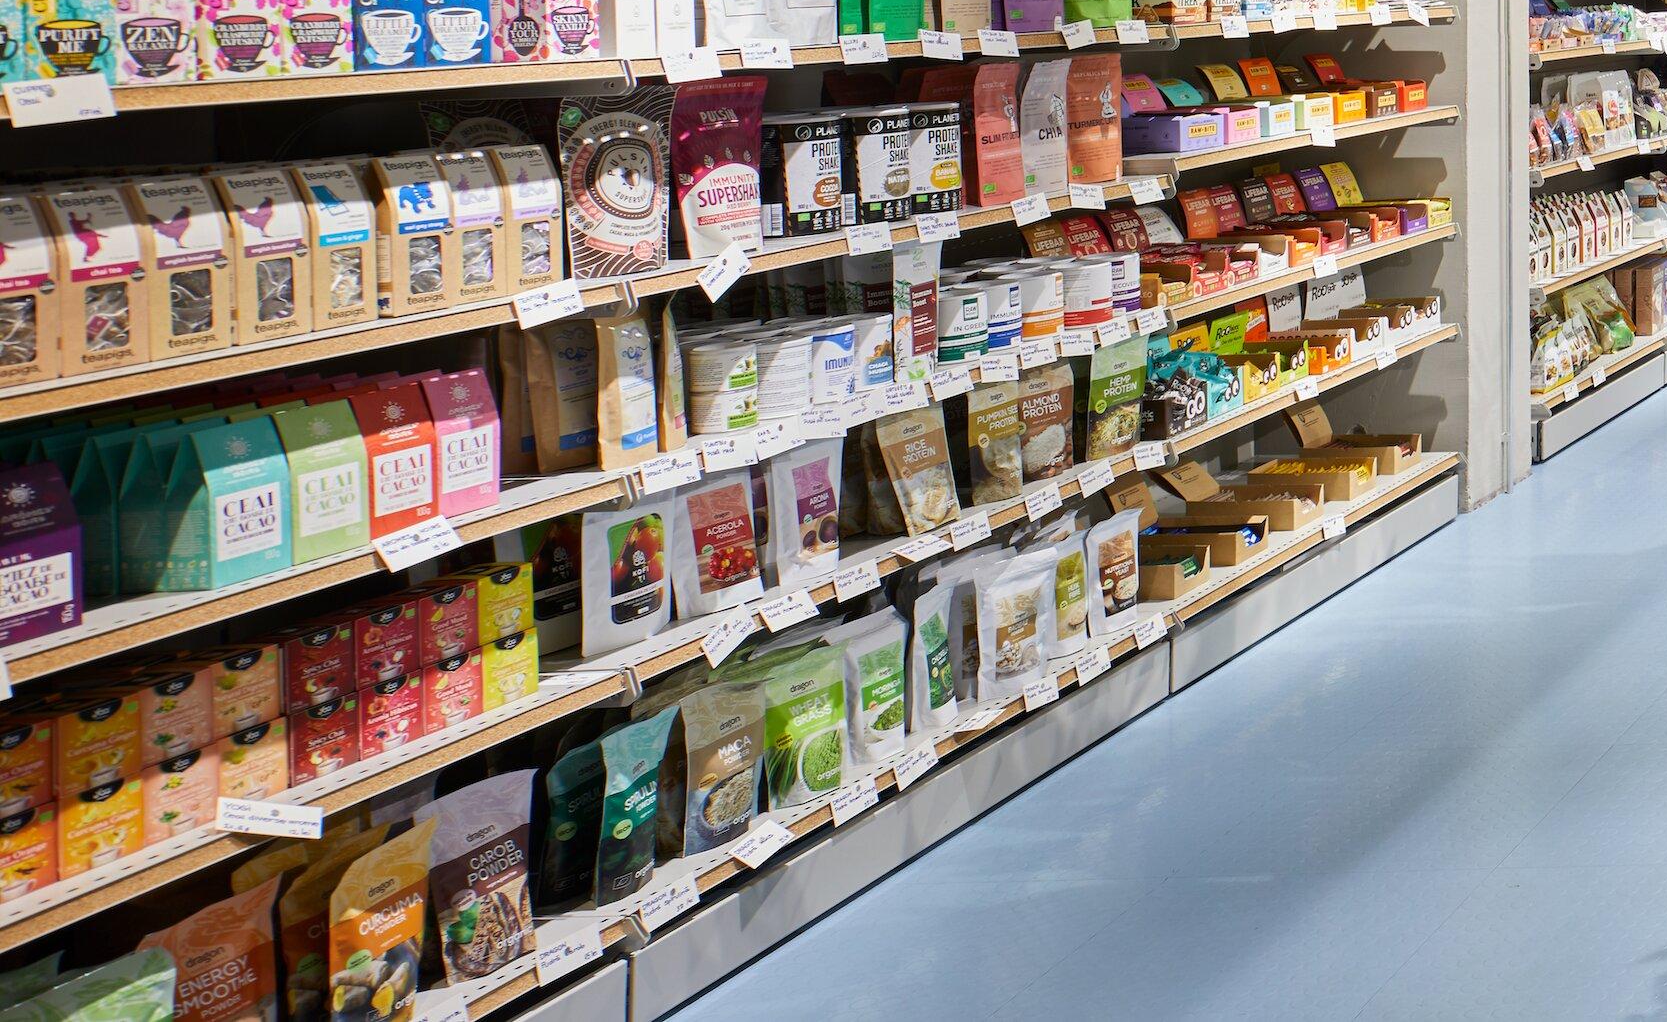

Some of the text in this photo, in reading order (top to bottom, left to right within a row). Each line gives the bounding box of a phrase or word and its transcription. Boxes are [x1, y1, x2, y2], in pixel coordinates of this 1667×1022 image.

[127, 27, 178, 43] ZEN
[509, 30, 538, 39] YOUR
[512, 21, 534, 31] FOR
[38, 28, 101, 44] PURIFY
[58, 40, 83, 54] ME
[981, 131, 999, 145] SLIM
[1038, 126, 1064, 140] CHIA
[935, 142, 958, 155] SHAKE
[709, 173, 755, 186] IMMUNITY
[1110, 219, 1140, 233] LIFEBAR
[1067, 230, 1098, 244] LIFEBAR
[1029, 381, 1048, 390] dragon
[1109, 374, 1132, 387] HEMP
[1103, 383, 1137, 398] PROTEIN
[1022, 394, 1060, 412] ALMOND
[1023, 403, 1062, 419] PROTEIN
[903, 423, 923, 434] dragon
[989, 415, 1019, 430] PROTEIN
[447, 433, 487, 454] CEAI
[904, 439, 927, 455] RICE
[379, 453, 425, 476] CEAI
[448, 454, 488, 473] CACAO
[903, 446, 937, 465] PROTEIN
[304, 471, 353, 494] CEAI
[380, 474, 426, 495] CACAO
[223, 492, 273, 511] CEAI
[305, 493, 355, 515] CACAO
[223, 514, 276, 538] CACAO
[706, 518, 745, 537] ACEROLA
[631, 566, 649, 577] KOFI
[790, 678, 815, 693] dragon
[788, 693, 829, 715] WHEAT
[719, 715, 741, 731] dragon
[793, 706, 832, 726] GRASS
[718, 736, 751, 760] MACA
[465, 825, 496, 844] dragon
[470, 838, 515, 871] CAROB
[467, 850, 524, 887] POWDER
[368, 878, 395, 898] dragon
[359, 892, 423, 936] CURCUMA
[374, 914, 407, 938] POWDER
[184, 945, 225, 970] dragon
[179, 955, 249, 999] ENERGY
